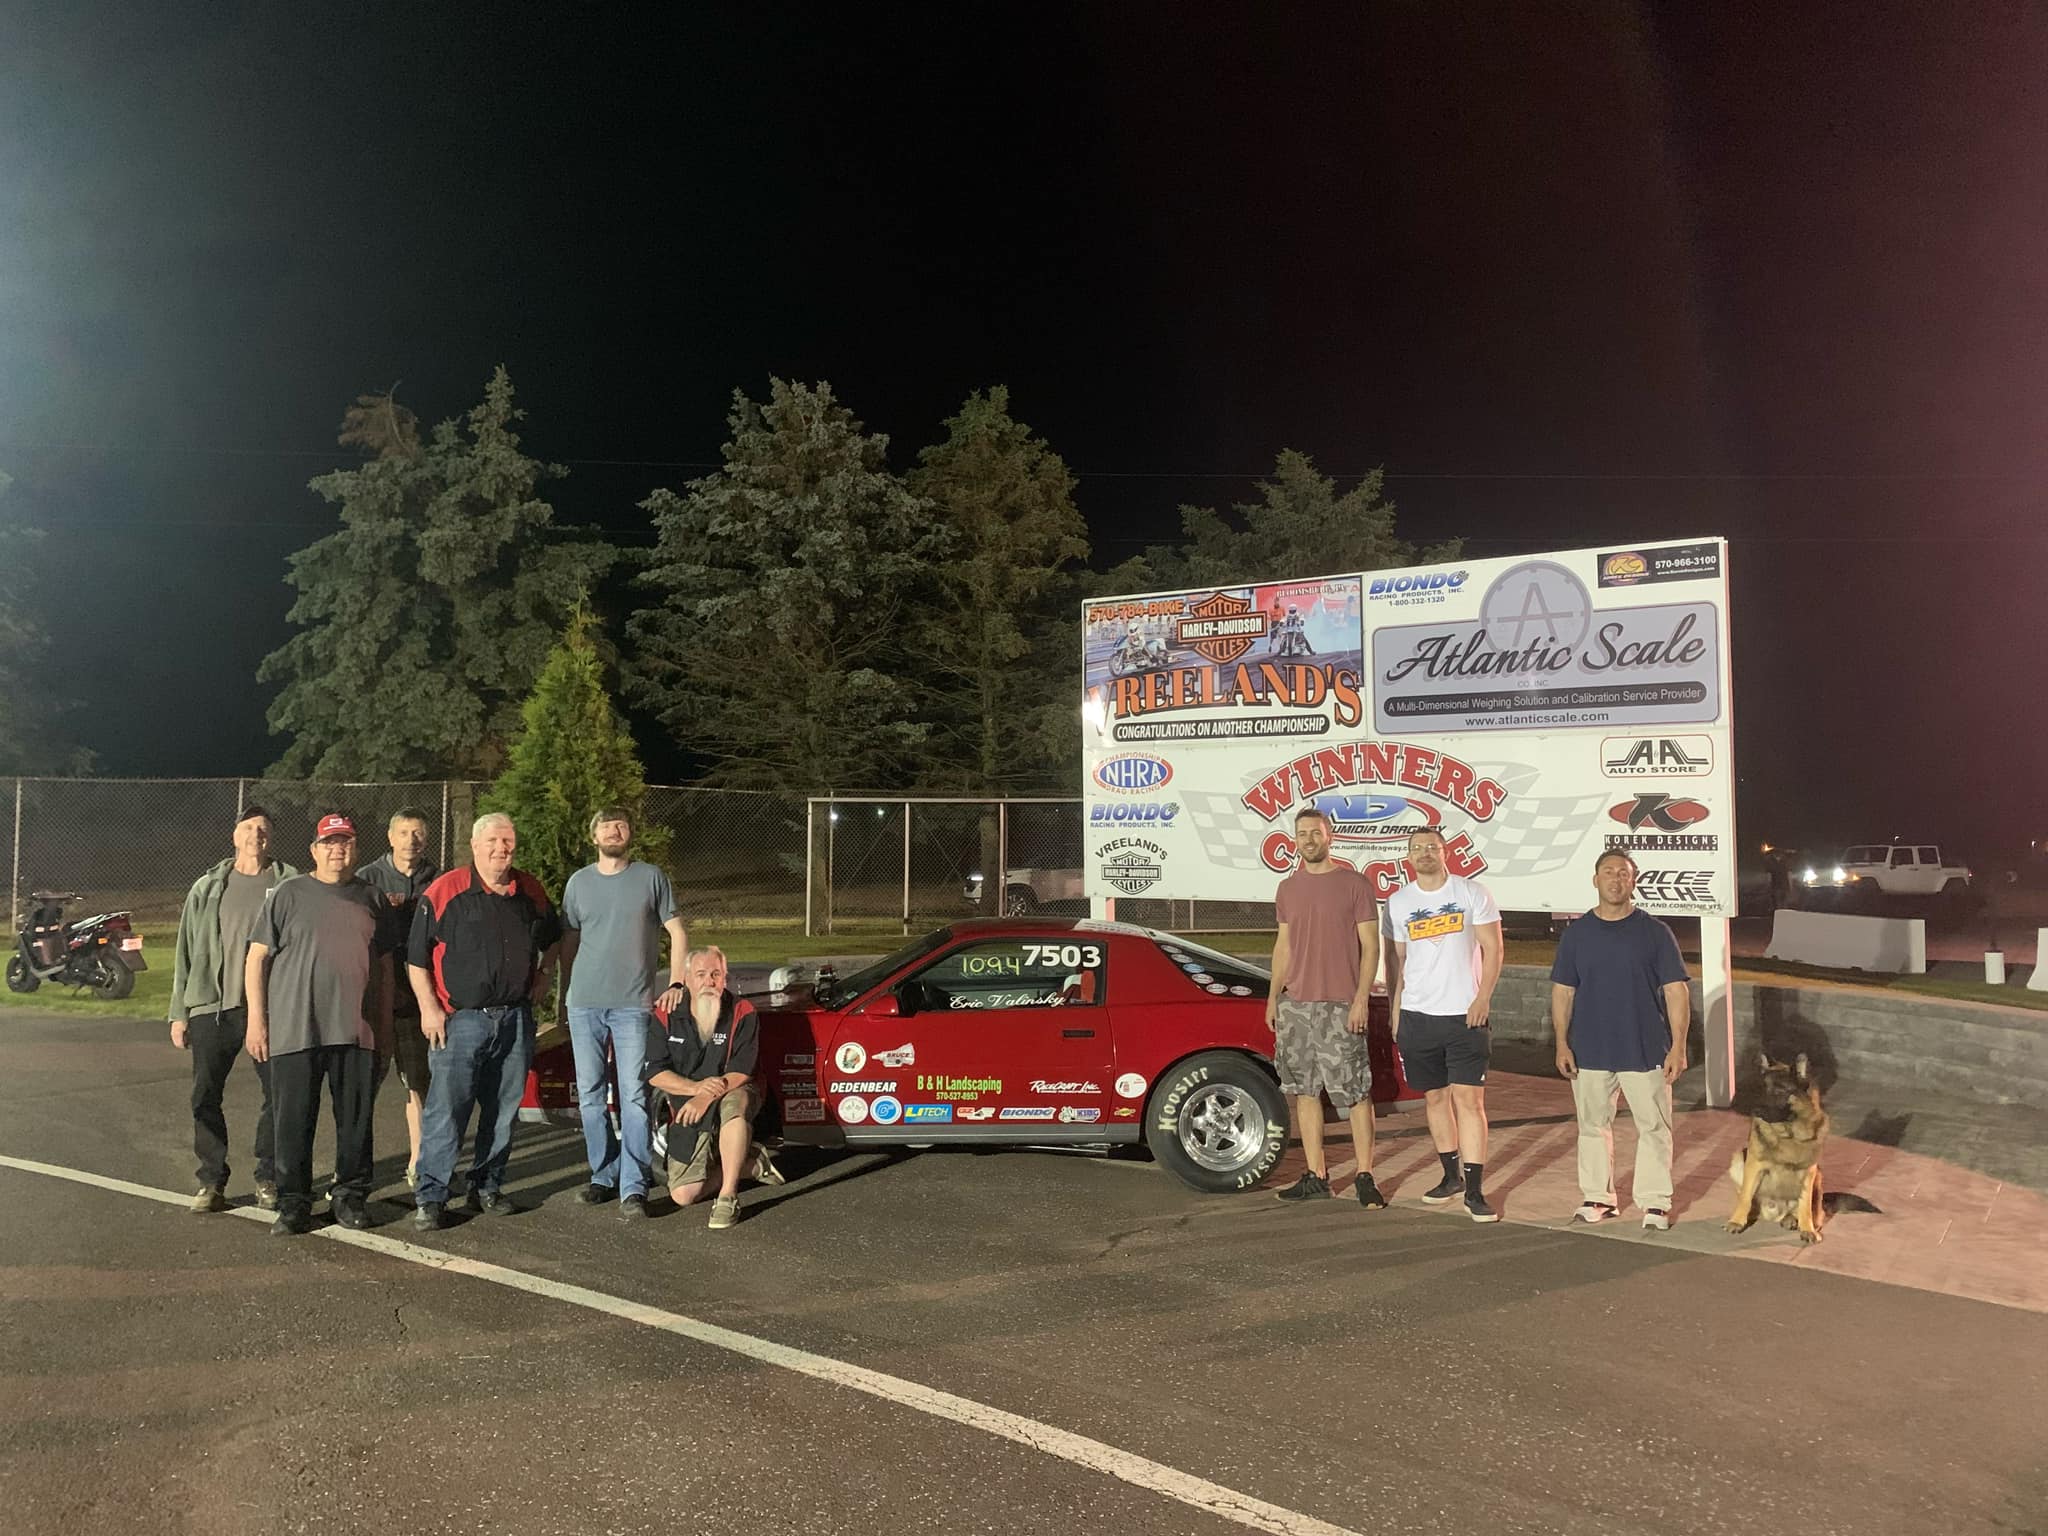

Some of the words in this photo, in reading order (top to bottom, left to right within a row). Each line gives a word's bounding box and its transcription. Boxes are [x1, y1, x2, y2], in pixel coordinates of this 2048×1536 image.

[1655, 555, 1717, 569] 570-966-3100
[1369, 571, 1468, 595] BIONDO
[1200, 601, 1242, 617] MOTOR
[1389, 596, 1445, 607] 1-800-332-1320
[1089, 600, 1185, 624] 570-784-BIKE
[1182, 616, 1263, 639] HARLEY-DAVIDSON
[1201, 638, 1245, 660] CYCLES
[1386, 628, 1572, 682] Atlantic
[1582, 612, 1707, 671] Scale
[1388, 704, 1395, 712] A
[1396, 698, 1470, 713] Multi-Dimensional
[1472, 697, 1512, 710] Weighing
[1513, 695, 1549, 707] Solution
[1551, 694, 1569, 704] and
[1571, 691, 1621, 704] Calibration
[1622, 689, 1658, 701] Service
[1660, 687, 1702, 700] Provider
[1116, 722, 1196, 739] CONGRATULATIONS
[1199, 721, 1211, 736] ON
[1212, 719, 1253, 735] ANOTHER
[1254, 716, 1325, 734] CHAMPIONSHIP
[1465, 712, 1609, 726] www.atlanticscale.com
[1105, 760, 1162, 786] NHRA
[1241, 741, 1508, 823] WINNERS
[1090, 802, 1178, 821] BIONDO
[1331, 825, 1377, 835] UMIDIA
[1095, 837, 1168, 861] VREELAND'S
[1605, 835, 1648, 845] KOREK
[1657, 835, 1718, 845] DESIGNS
[1637, 870, 1697, 885] ACE
[1631, 886, 1698, 901] ECH
[1022, 945, 1101, 968] 7503
[950, 995, 984, 1009] Eric
[830, 1081, 897, 1093] DEDENBEAR
[917, 1075, 924, 1090] B
[926, 1075, 934, 1090] &
[936, 1075, 943, 1090] H
[945, 1075, 1002, 1095] Landscaping
[1001, 1109, 1053, 1117] BIONDO
